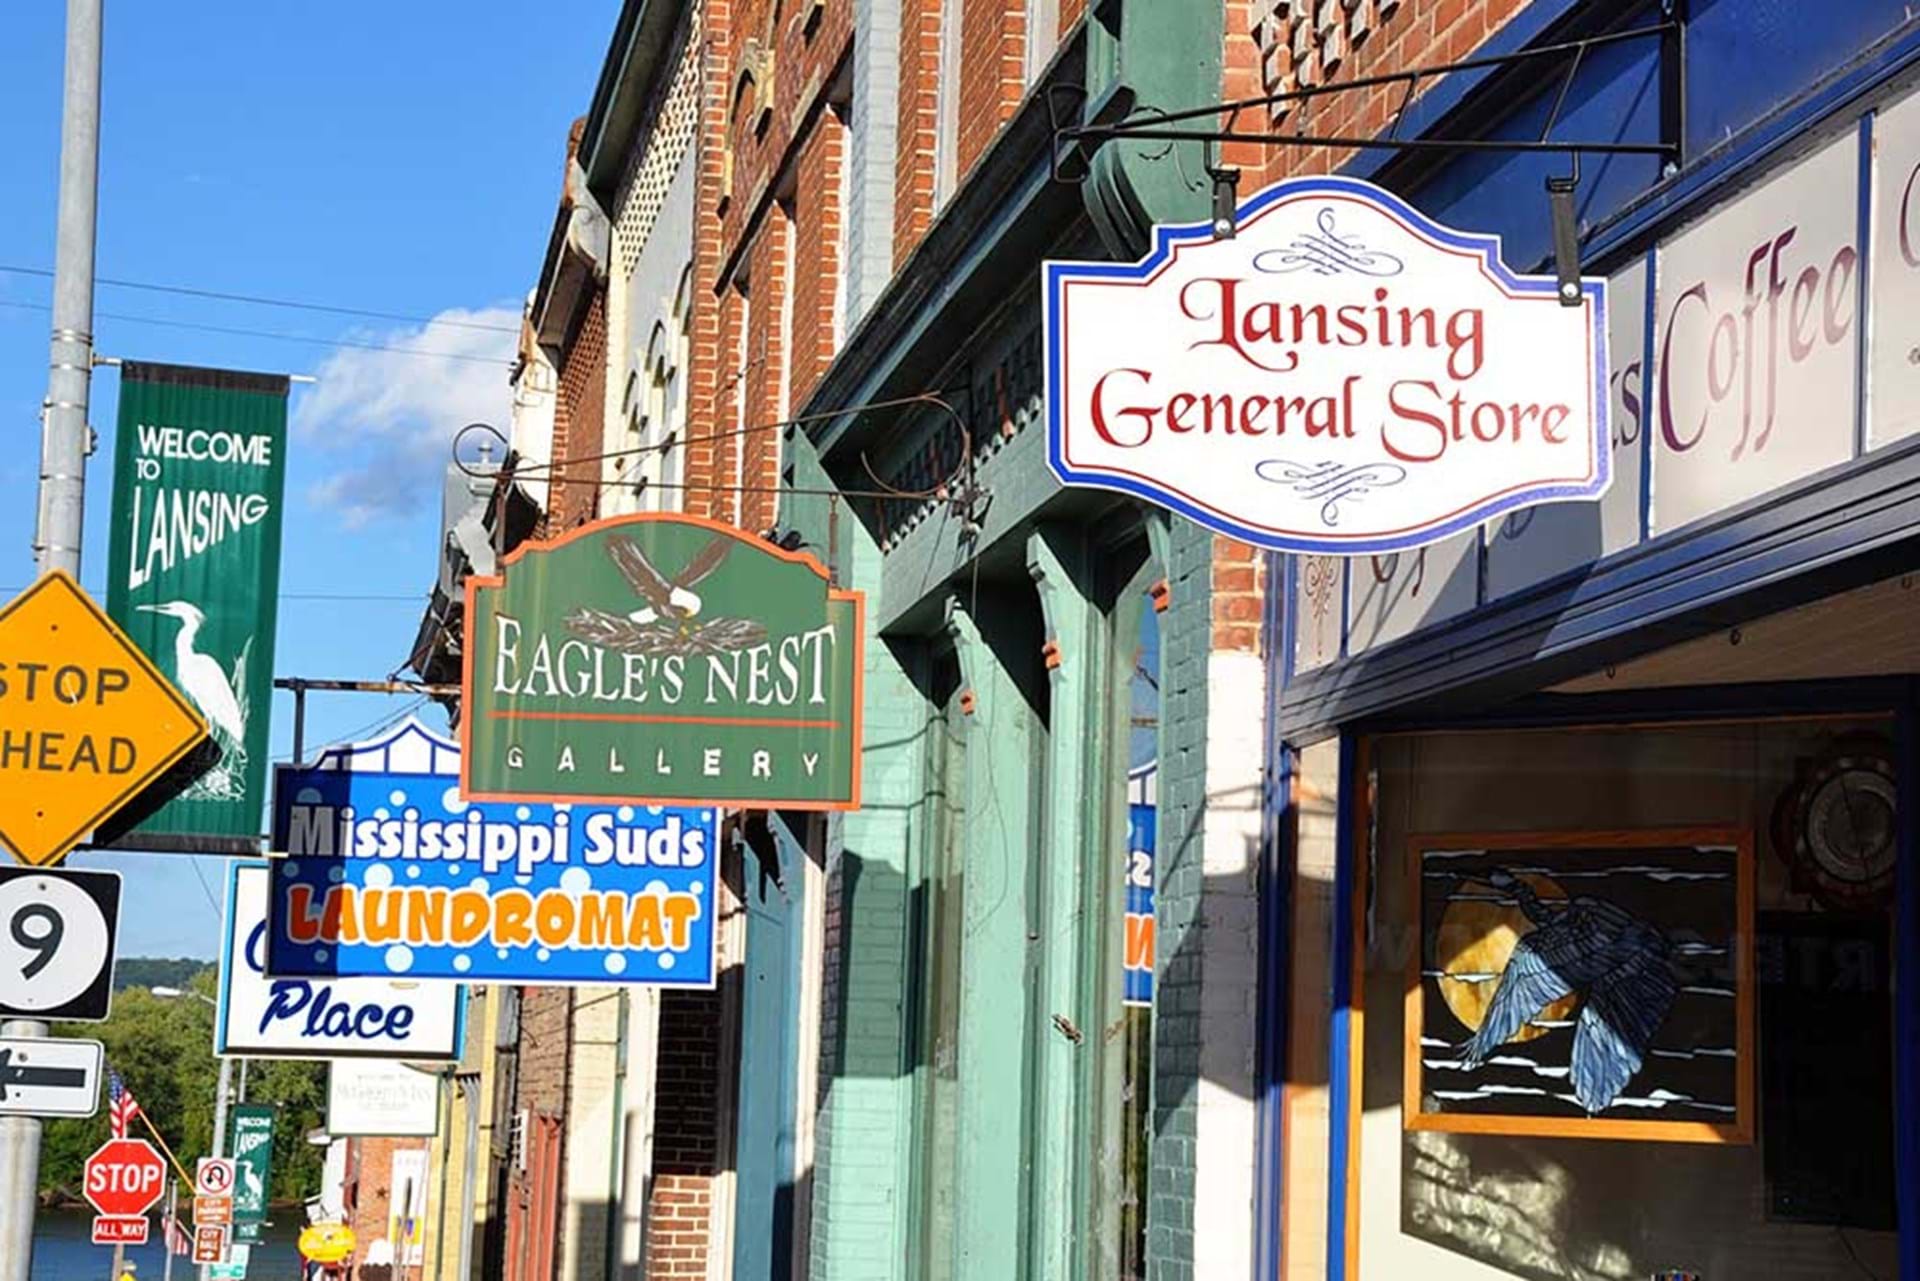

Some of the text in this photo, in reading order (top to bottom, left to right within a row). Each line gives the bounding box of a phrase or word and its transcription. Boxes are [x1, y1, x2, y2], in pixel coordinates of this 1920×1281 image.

[1180, 277, 1484, 380] Lansing
[1659, 226, 1858, 463] Coffee
[137, 425, 271, 466] WELCOME
[1090, 368, 1362, 448] General
[1381, 379, 1572, 462] Store
[136, 458, 160, 481] TO
[128, 485, 269, 591] LANSING
[0, 663, 130, 706] TOP
[493, 612, 836, 706] EAGLE'S NEST
[1, 730, 137, 774] HEAD
[508, 746, 818, 780] GALLERY
[288, 805, 704, 875] Mississippi Suds
[10, 902, 65, 981] 9
[287, 885, 700, 951] LAUNDROMAT
[259, 979, 414, 1039] Place
[89, 1163, 160, 1194] STOP
[97, 1223, 145, 1236] ALL WAY
